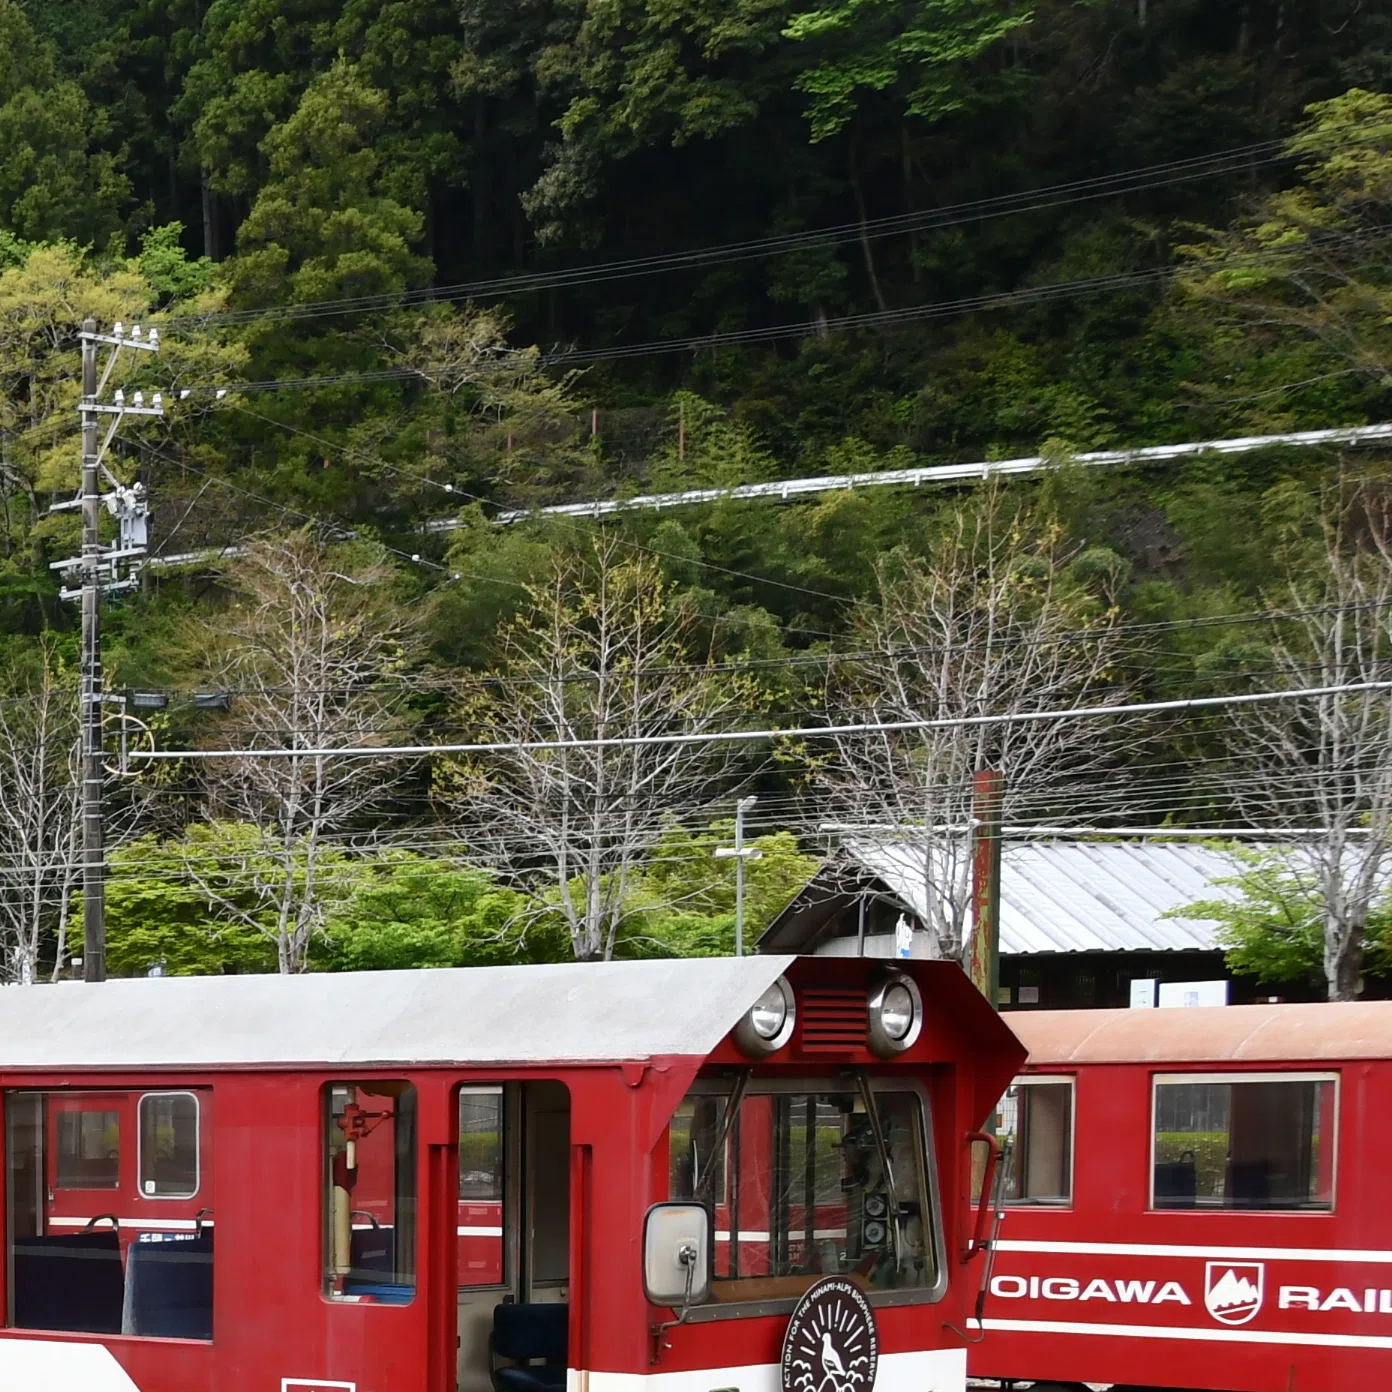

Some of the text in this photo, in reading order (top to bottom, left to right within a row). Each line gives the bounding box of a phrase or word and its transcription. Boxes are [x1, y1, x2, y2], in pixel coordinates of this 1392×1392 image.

[990, 1274, 1192, 1306] OIGAWA
[784, 1282, 877, 1389] ACTION FOR THE MINAMI-ALPS BIOSPHERE RESERVE
